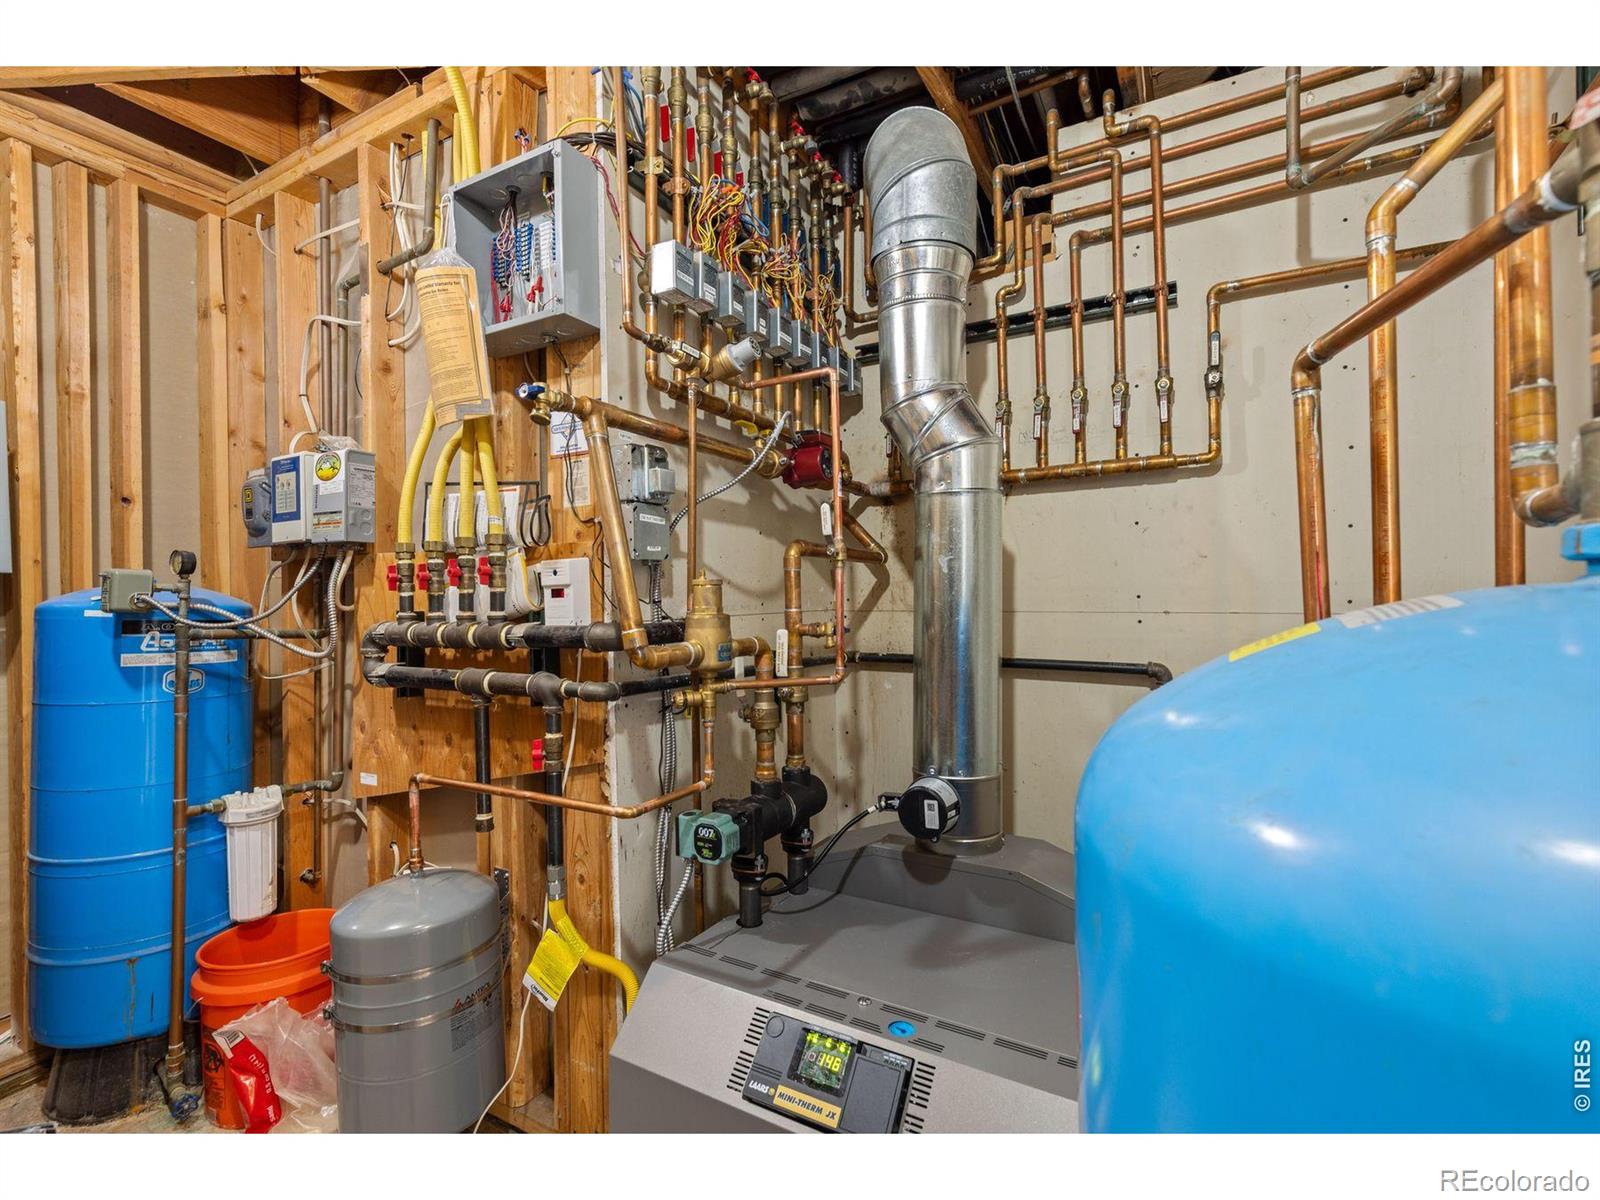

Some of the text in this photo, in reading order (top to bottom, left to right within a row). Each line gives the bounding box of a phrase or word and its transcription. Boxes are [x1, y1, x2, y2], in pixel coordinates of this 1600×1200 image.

[749, 1080, 769, 1095] LAARS
[777, 1090, 837, 1120] MINI-THERM JX
